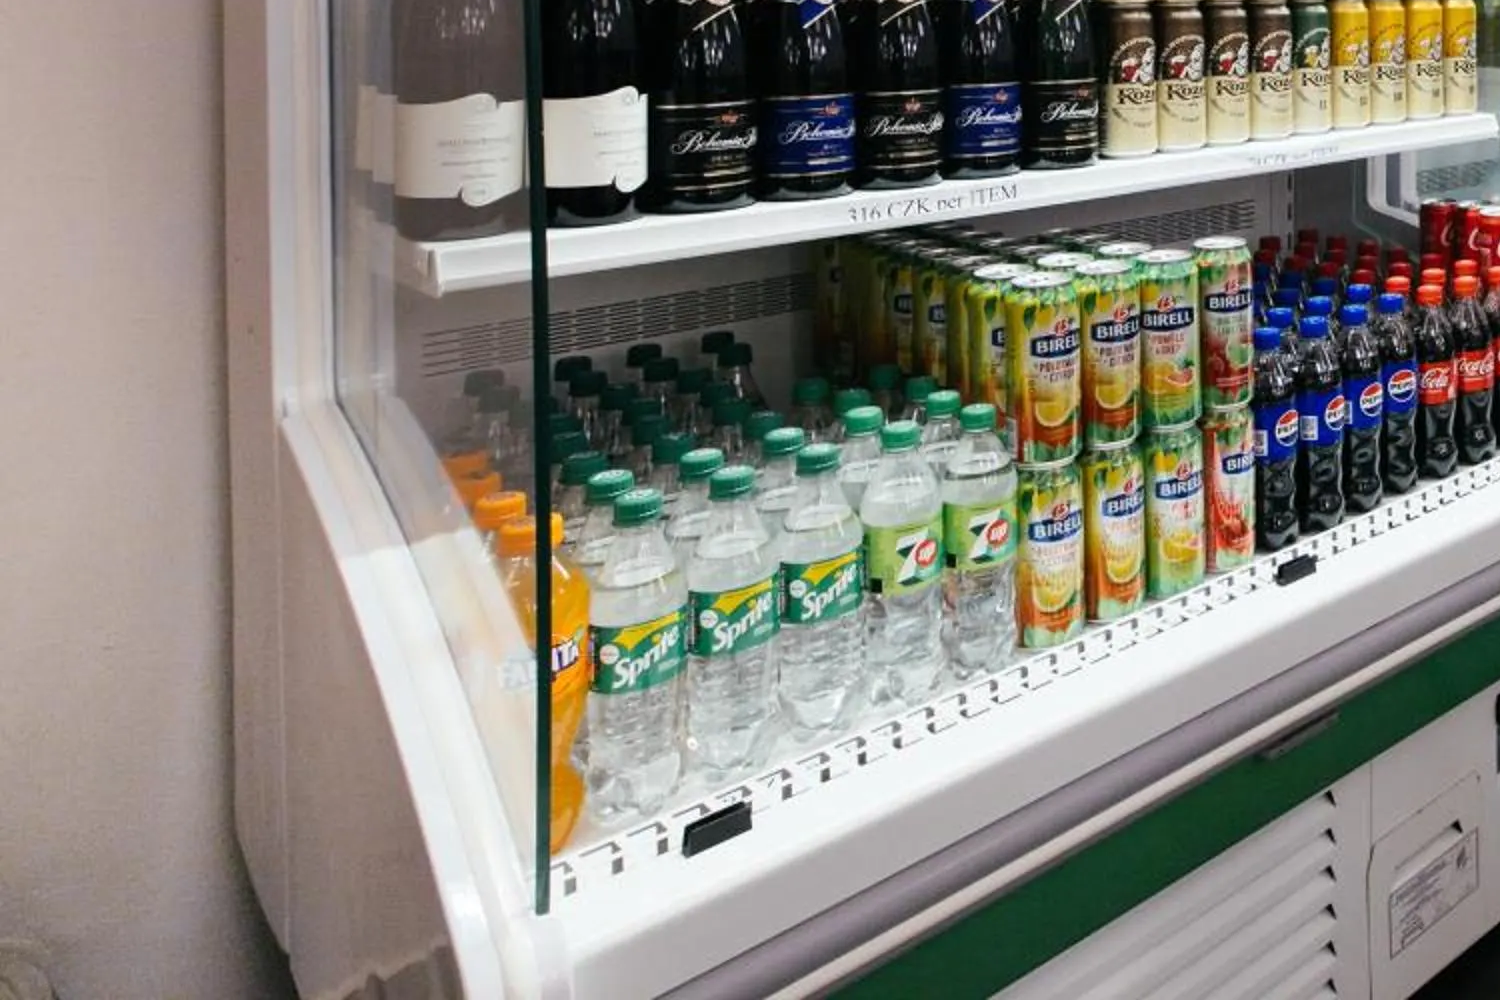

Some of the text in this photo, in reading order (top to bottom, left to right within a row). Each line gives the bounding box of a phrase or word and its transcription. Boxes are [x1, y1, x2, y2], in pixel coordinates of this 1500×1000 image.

[887, 198, 930, 217] CZK
[970, 184, 1017, 206] ITEM
[1143, 311, 1192, 328] BIRELL
[802, 564, 857, 619] Sprite
[711, 592, 772, 650] Sprite
[612, 625, 679, 689] Sprite
